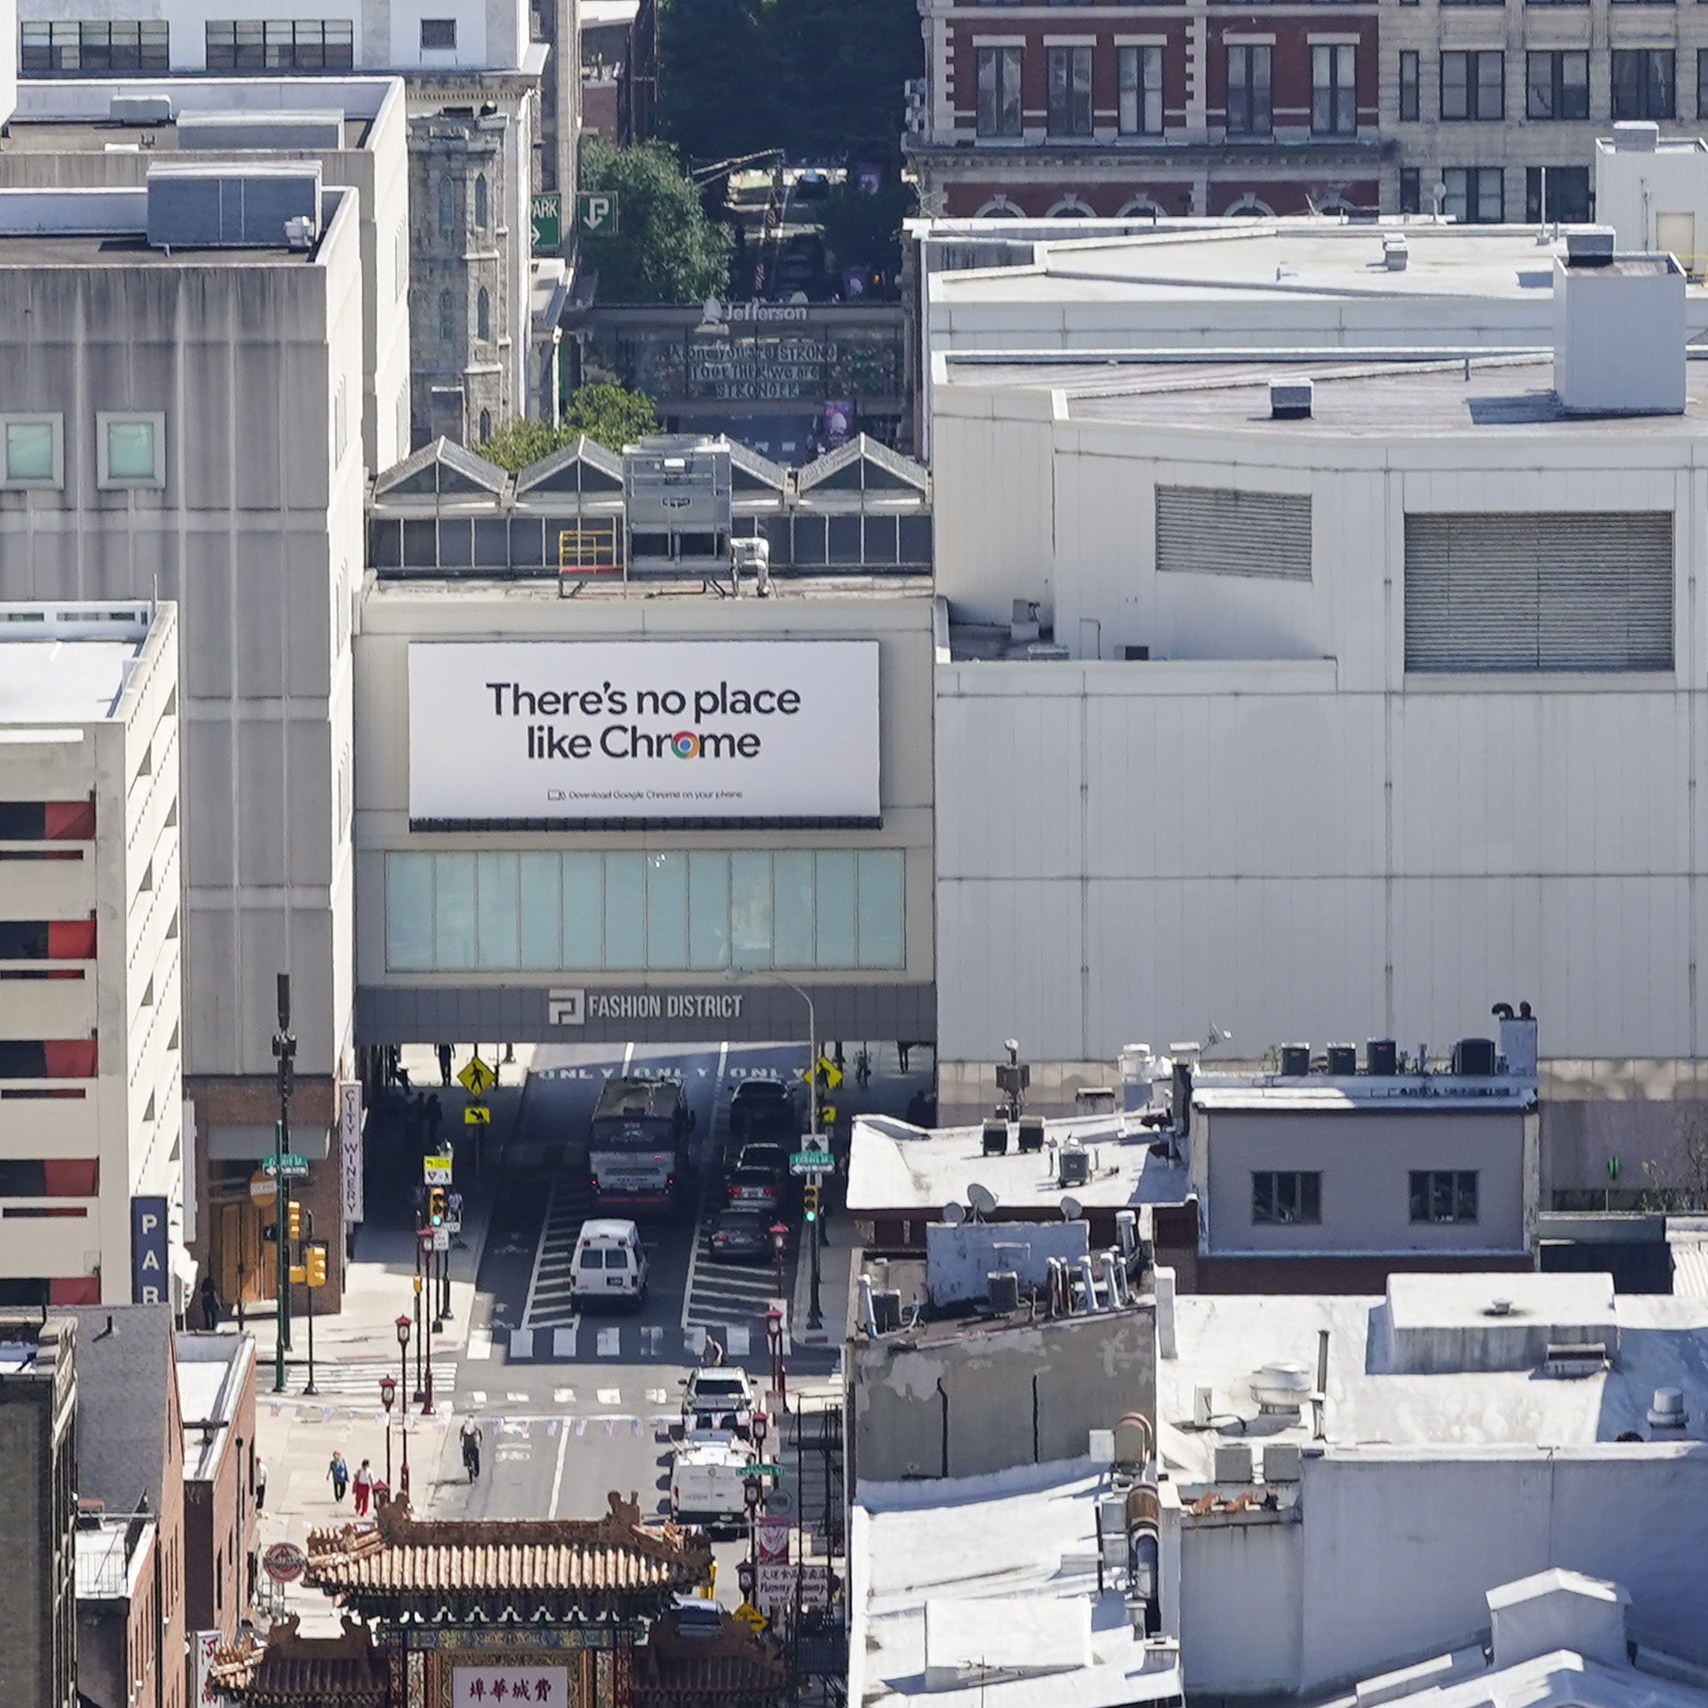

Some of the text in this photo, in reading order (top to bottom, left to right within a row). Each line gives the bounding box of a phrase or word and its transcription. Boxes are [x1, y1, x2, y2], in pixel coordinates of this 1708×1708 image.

[724, 304, 808, 322] Jefferson
[485, 681, 802, 724] There's no place
[527, 725, 761, 760] like Chrome
[569, 789, 743, 802] Download Google Chrome on your phone
[589, 994, 743, 1019] FASHION DISTRICT
[343, 1089, 359, 1214] CITY WINERY
